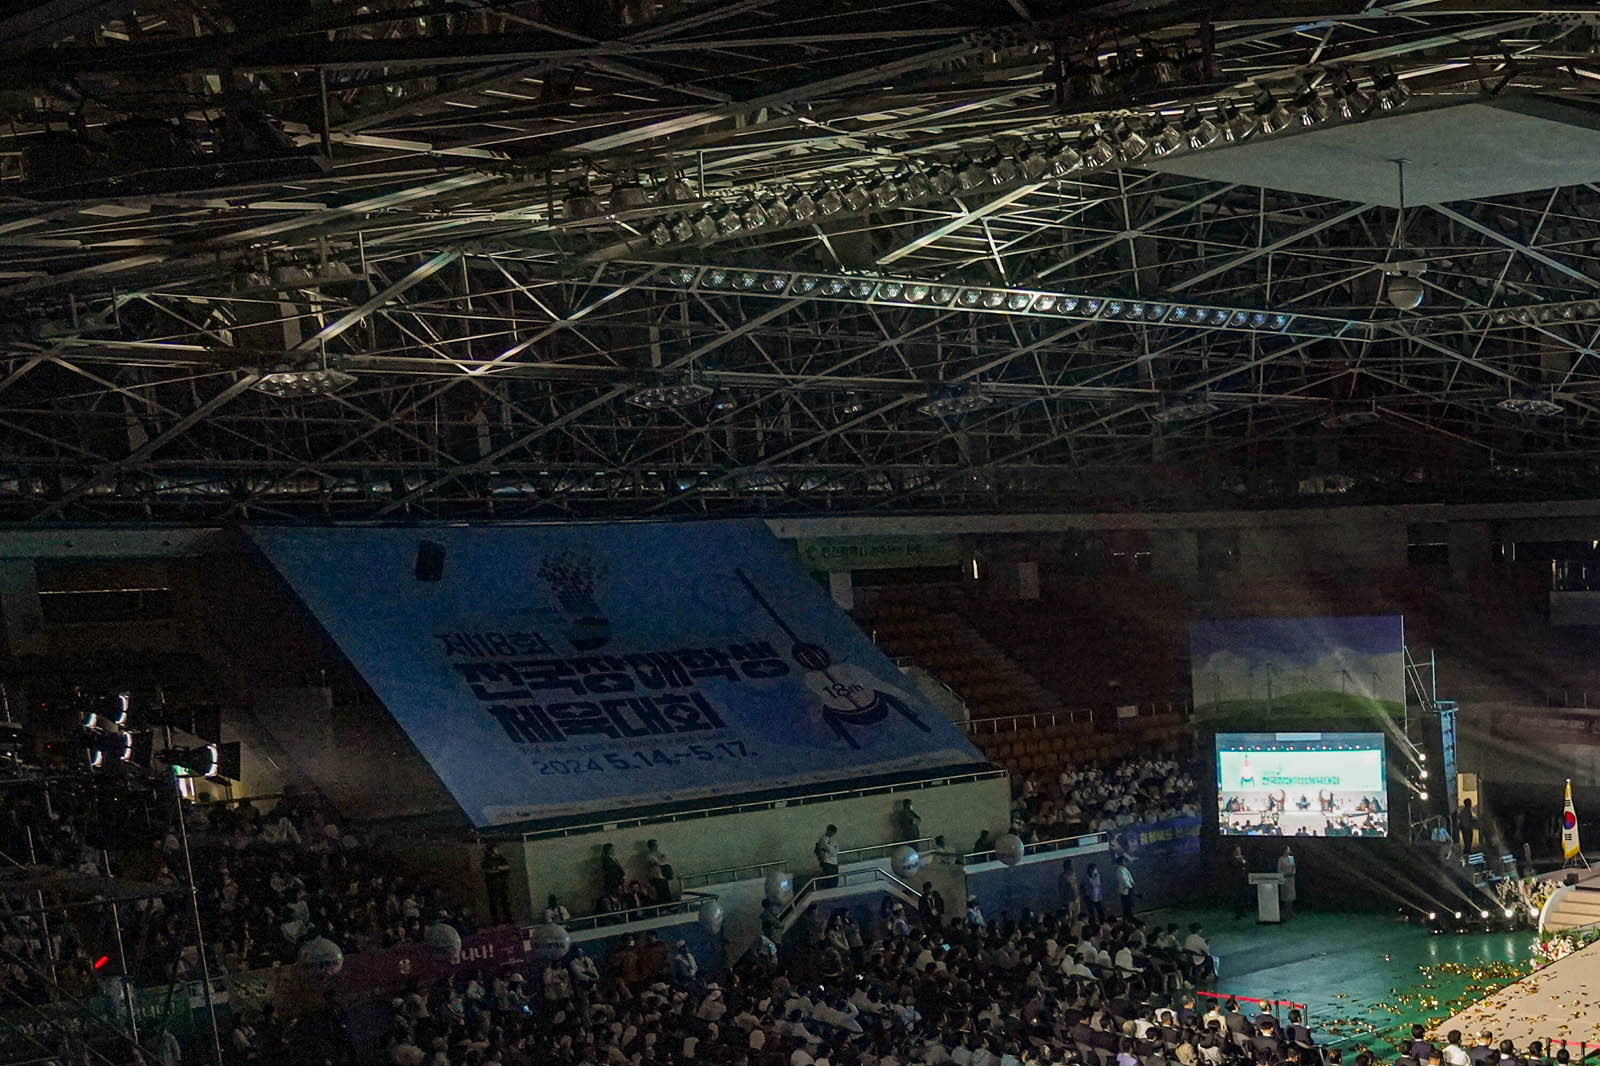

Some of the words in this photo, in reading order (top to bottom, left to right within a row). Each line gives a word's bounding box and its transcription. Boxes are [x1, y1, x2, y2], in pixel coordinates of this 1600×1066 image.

[435, 632, 556, 658] 제18회
[454, 641, 790, 702] 전국장애학생
[487, 692, 727, 744] 체육대회
[532, 759, 605, 776] 2024
